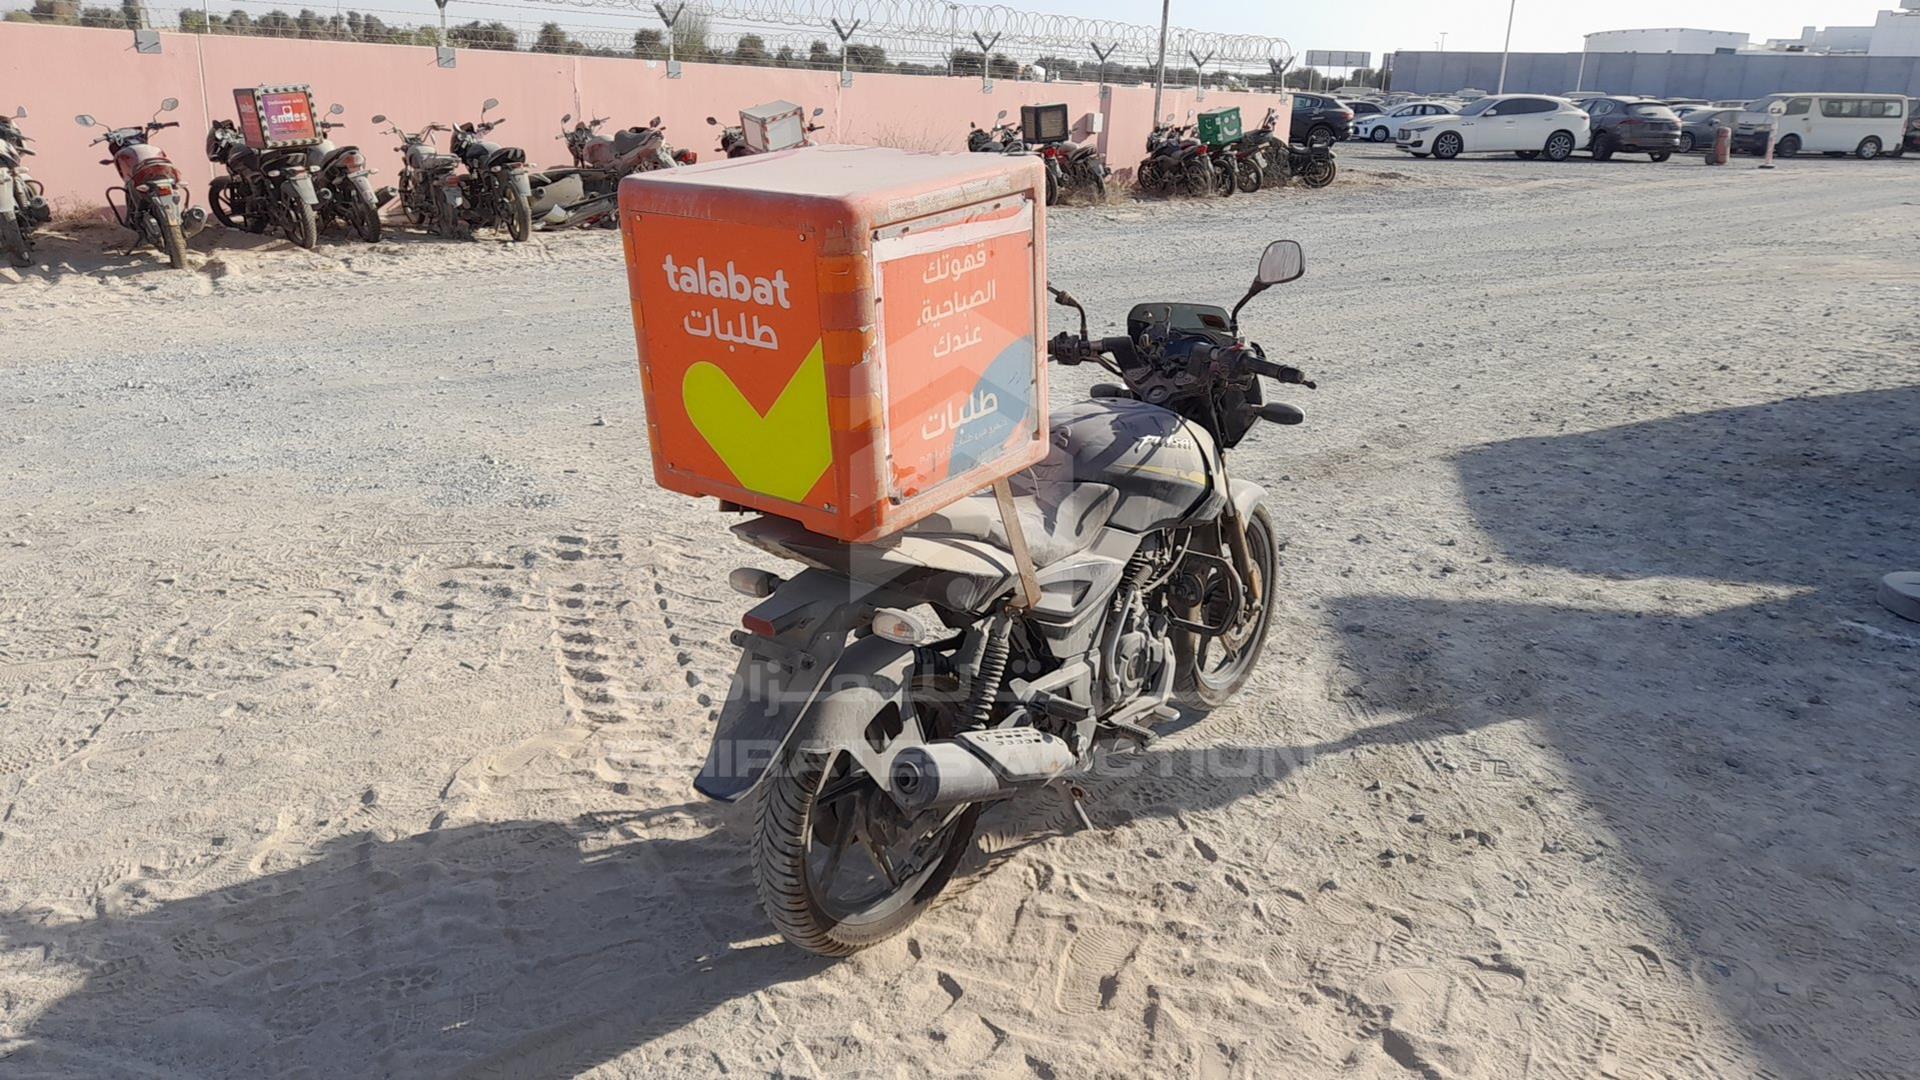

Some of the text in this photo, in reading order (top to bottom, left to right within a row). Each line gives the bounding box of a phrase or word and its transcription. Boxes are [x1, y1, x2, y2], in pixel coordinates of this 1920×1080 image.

[662, 253, 791, 310] talabat
[922, 242, 987, 285] قهوتك
[683, 307, 779, 352] طلبات
[932, 325, 983, 359] عندك
[921, 388, 999, 441] طلبات
